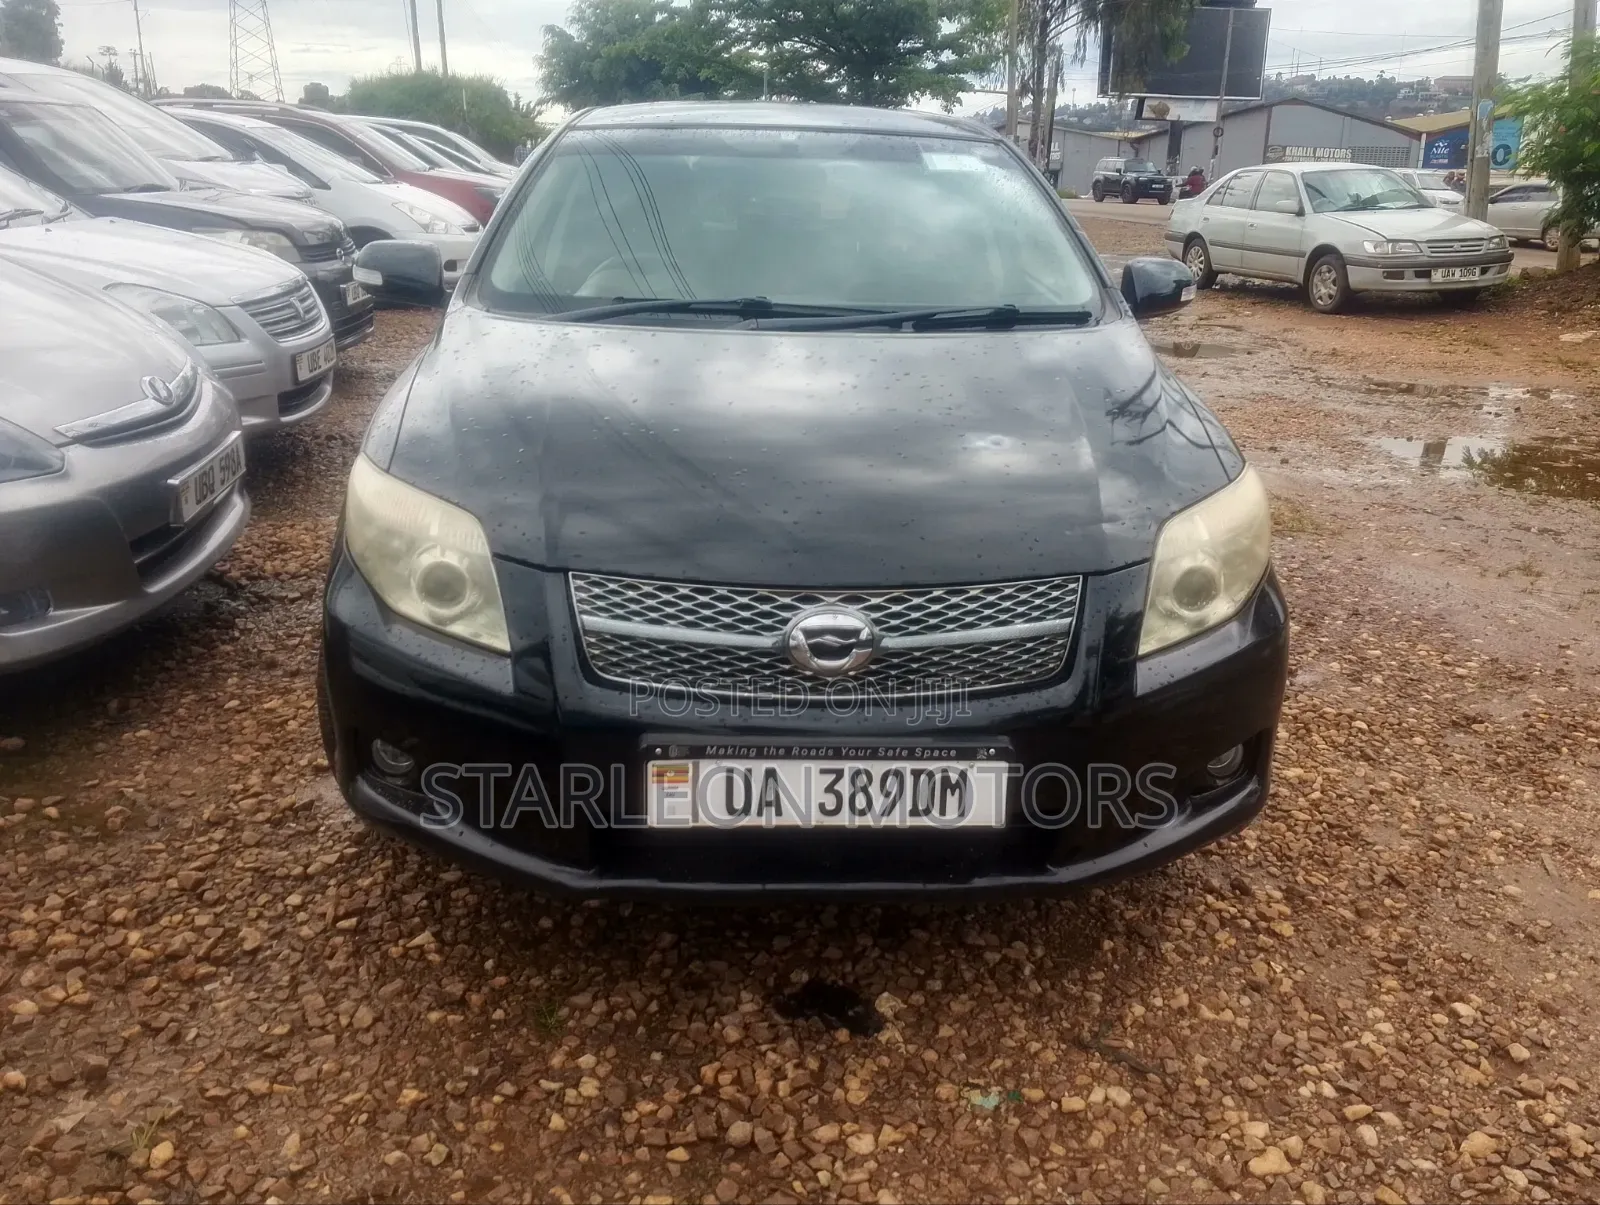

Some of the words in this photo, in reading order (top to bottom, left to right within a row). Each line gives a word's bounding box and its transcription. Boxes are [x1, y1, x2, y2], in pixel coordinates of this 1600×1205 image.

[1285, 146, 1315, 157] KHALIL
[1315, 147, 1352, 159] MOTORS
[1441, 268, 1457, 279] UAW
[1459, 267, 1477, 278] 109G
[307, 348, 322, 374] UBE
[194, 464, 216, 506] UBQ
[705, 745, 757, 758] Making
[764, 745, 786, 756] the
[791, 746, 834, 757] Roads
[841, 746, 872, 757] Your
[878, 746, 909, 757] Safe
[915, 747, 957, 759] Space
[724, 765, 784, 818] UA
[817, 765, 970, 818] 389DM
